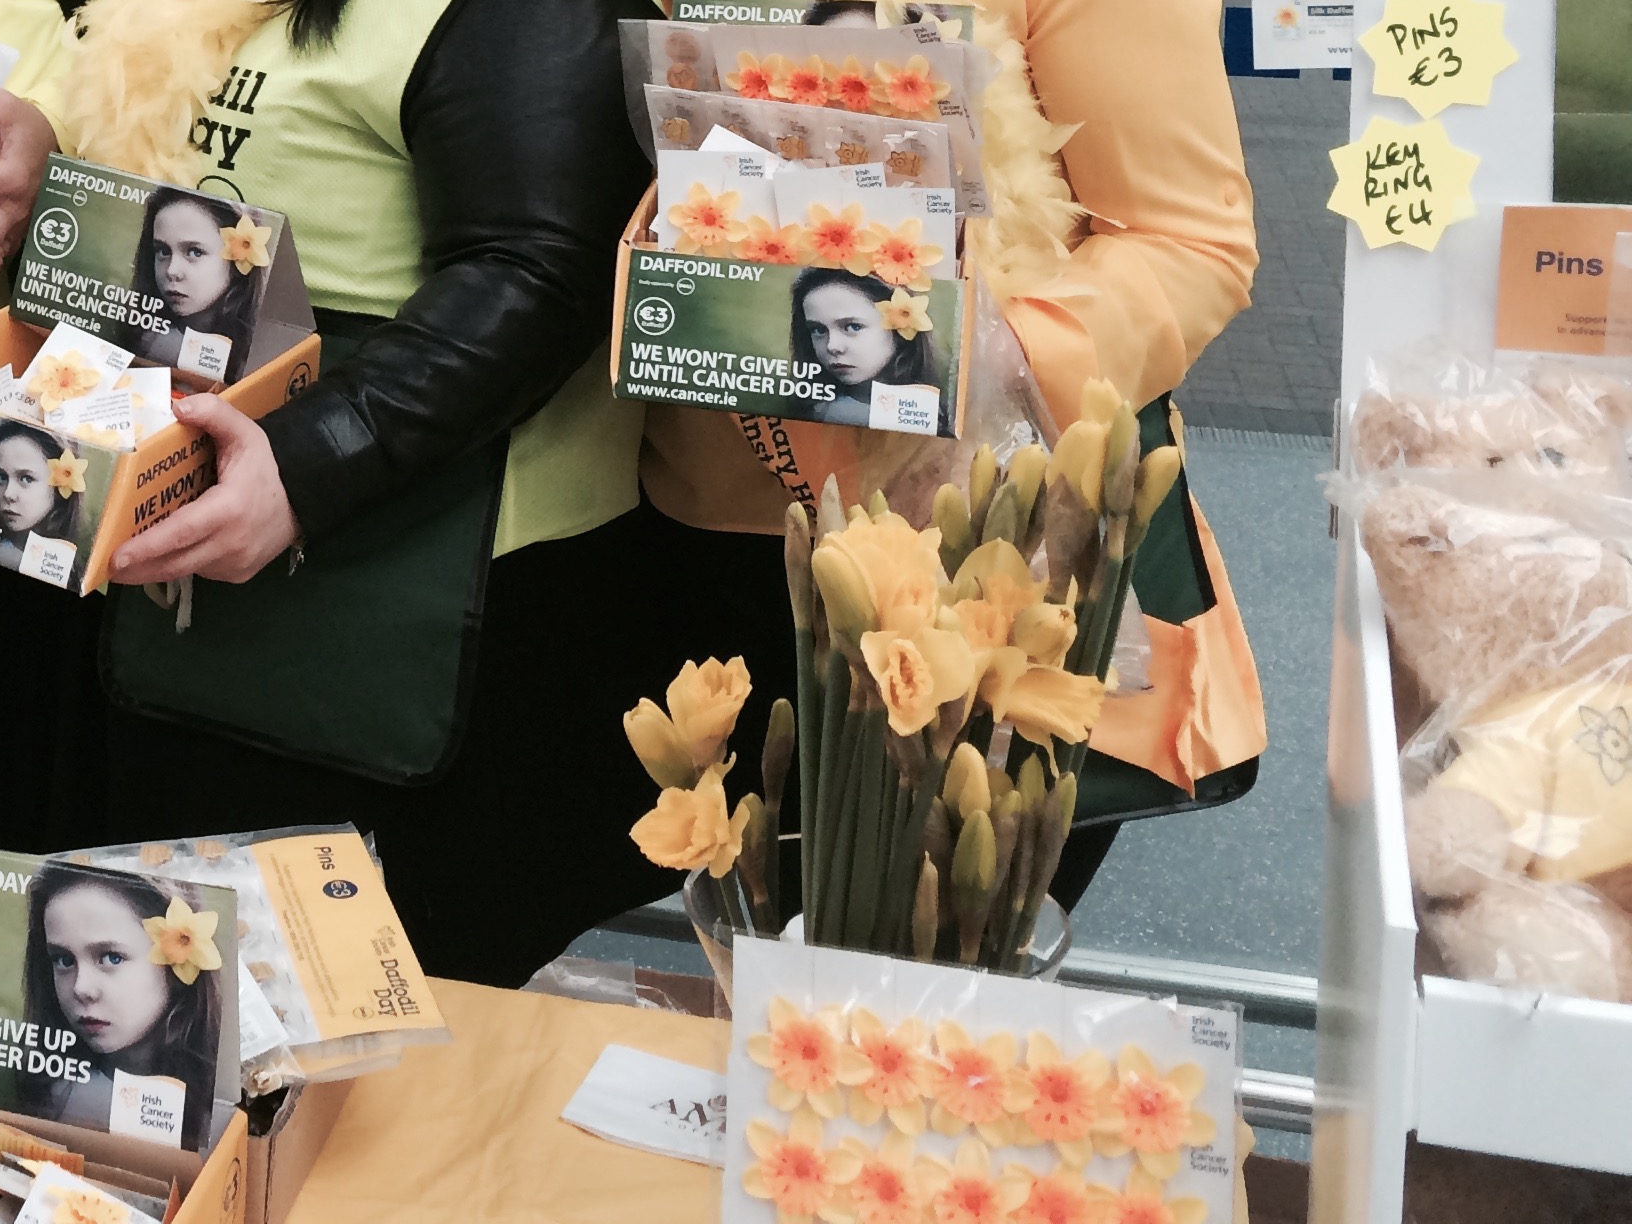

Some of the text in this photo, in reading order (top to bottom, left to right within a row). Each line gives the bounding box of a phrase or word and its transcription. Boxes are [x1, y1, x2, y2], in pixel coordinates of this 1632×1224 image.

[678, 3, 806, 24] DAFFODIL DAY
[1387, 6, 1459, 56] PINS
[1408, 46, 1463, 87] €3
[49, 165, 152, 206] DAFFODIL DAY
[1364, 164, 1432, 207] RING
[926, 200, 951, 208] Cancer
[926, 207, 953, 215] Society
[1386, 199, 1432, 236] €4
[39, 218, 73, 242] €3
[39, 237, 65, 251] Daffodil
[639, 255, 765, 282] DAFFODIL DAY
[1535, 250, 1604, 277] Pins
[25, 260, 165, 314] WE WON'T GIVE UP
[16, 298, 101, 333] www.cancer.ie
[20, 277, 172, 336] UNTIL CANCER DOES
[639, 305, 668, 323] €3
[198, 352, 222, 365] Cancer
[200, 345, 215, 355] Irish
[630, 342, 822, 379] WE WON'T GIVE UP
[197, 359, 221, 373] Society
[629, 361, 836, 402] UNTIL CANCER DOES
[626, 382, 738, 407] www.cancer.ie
[898, 398, 918, 409] Irish
[897, 407, 930, 418] Cancer
[897, 416, 931, 428] Society
[136, 446, 189, 490] DAFFODIL
[134, 494, 157, 526] WE
[41, 558, 65, 572] Cancer
[43, 550, 59, 562] Irish
[39, 565, 65, 582] Society
[314, 845, 352, 898] Pins €3
[380, 958, 421, 1016] Daffodil
[373, 987, 398, 1018] Day
[1191, 1015, 1216, 1028] Irish
[1191, 1025, 1228, 1039] Cancer
[43, 1028, 77, 1054] UP
[1191, 1035, 1231, 1051] Society
[28, 1051, 92, 1085] DOES
[139, 1092, 163, 1107] Irish
[139, 1104, 175, 1121] Cancer
[139, 1115, 176, 1134] Society
[1190, 1151, 1227, 1165] Cancer
[1190, 1160, 1230, 1176] Society
